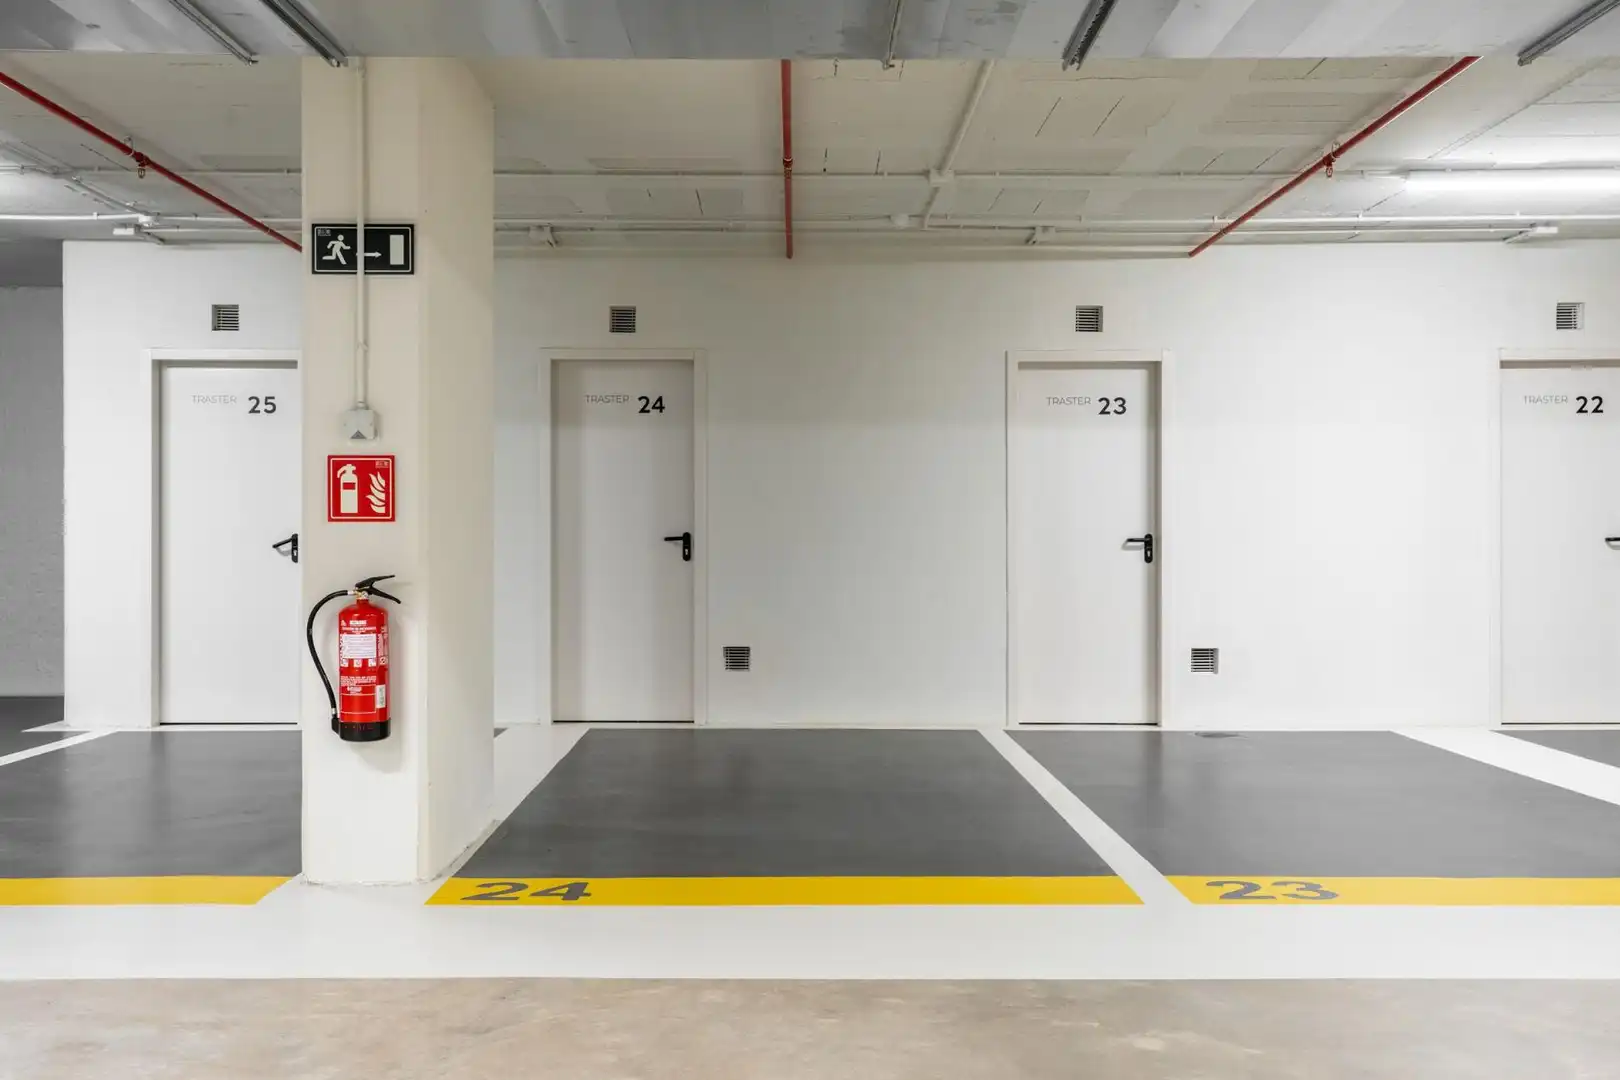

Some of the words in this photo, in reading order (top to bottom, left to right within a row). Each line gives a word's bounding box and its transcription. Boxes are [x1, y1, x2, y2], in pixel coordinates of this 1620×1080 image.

[191, 395, 237, 404] TRASTER
[248, 396, 277, 414] 25
[585, 395, 630, 404] TRASTER
[638, 395, 666, 414] 24
[1046, 396, 1092, 406] TRASTER
[1098, 397, 1127, 415] 23
[1523, 395, 1568, 404] TRASTER
[1575, 395, 1604, 414] 22
[460, 882, 592, 901] 24
[1205, 880, 1339, 901] 23
